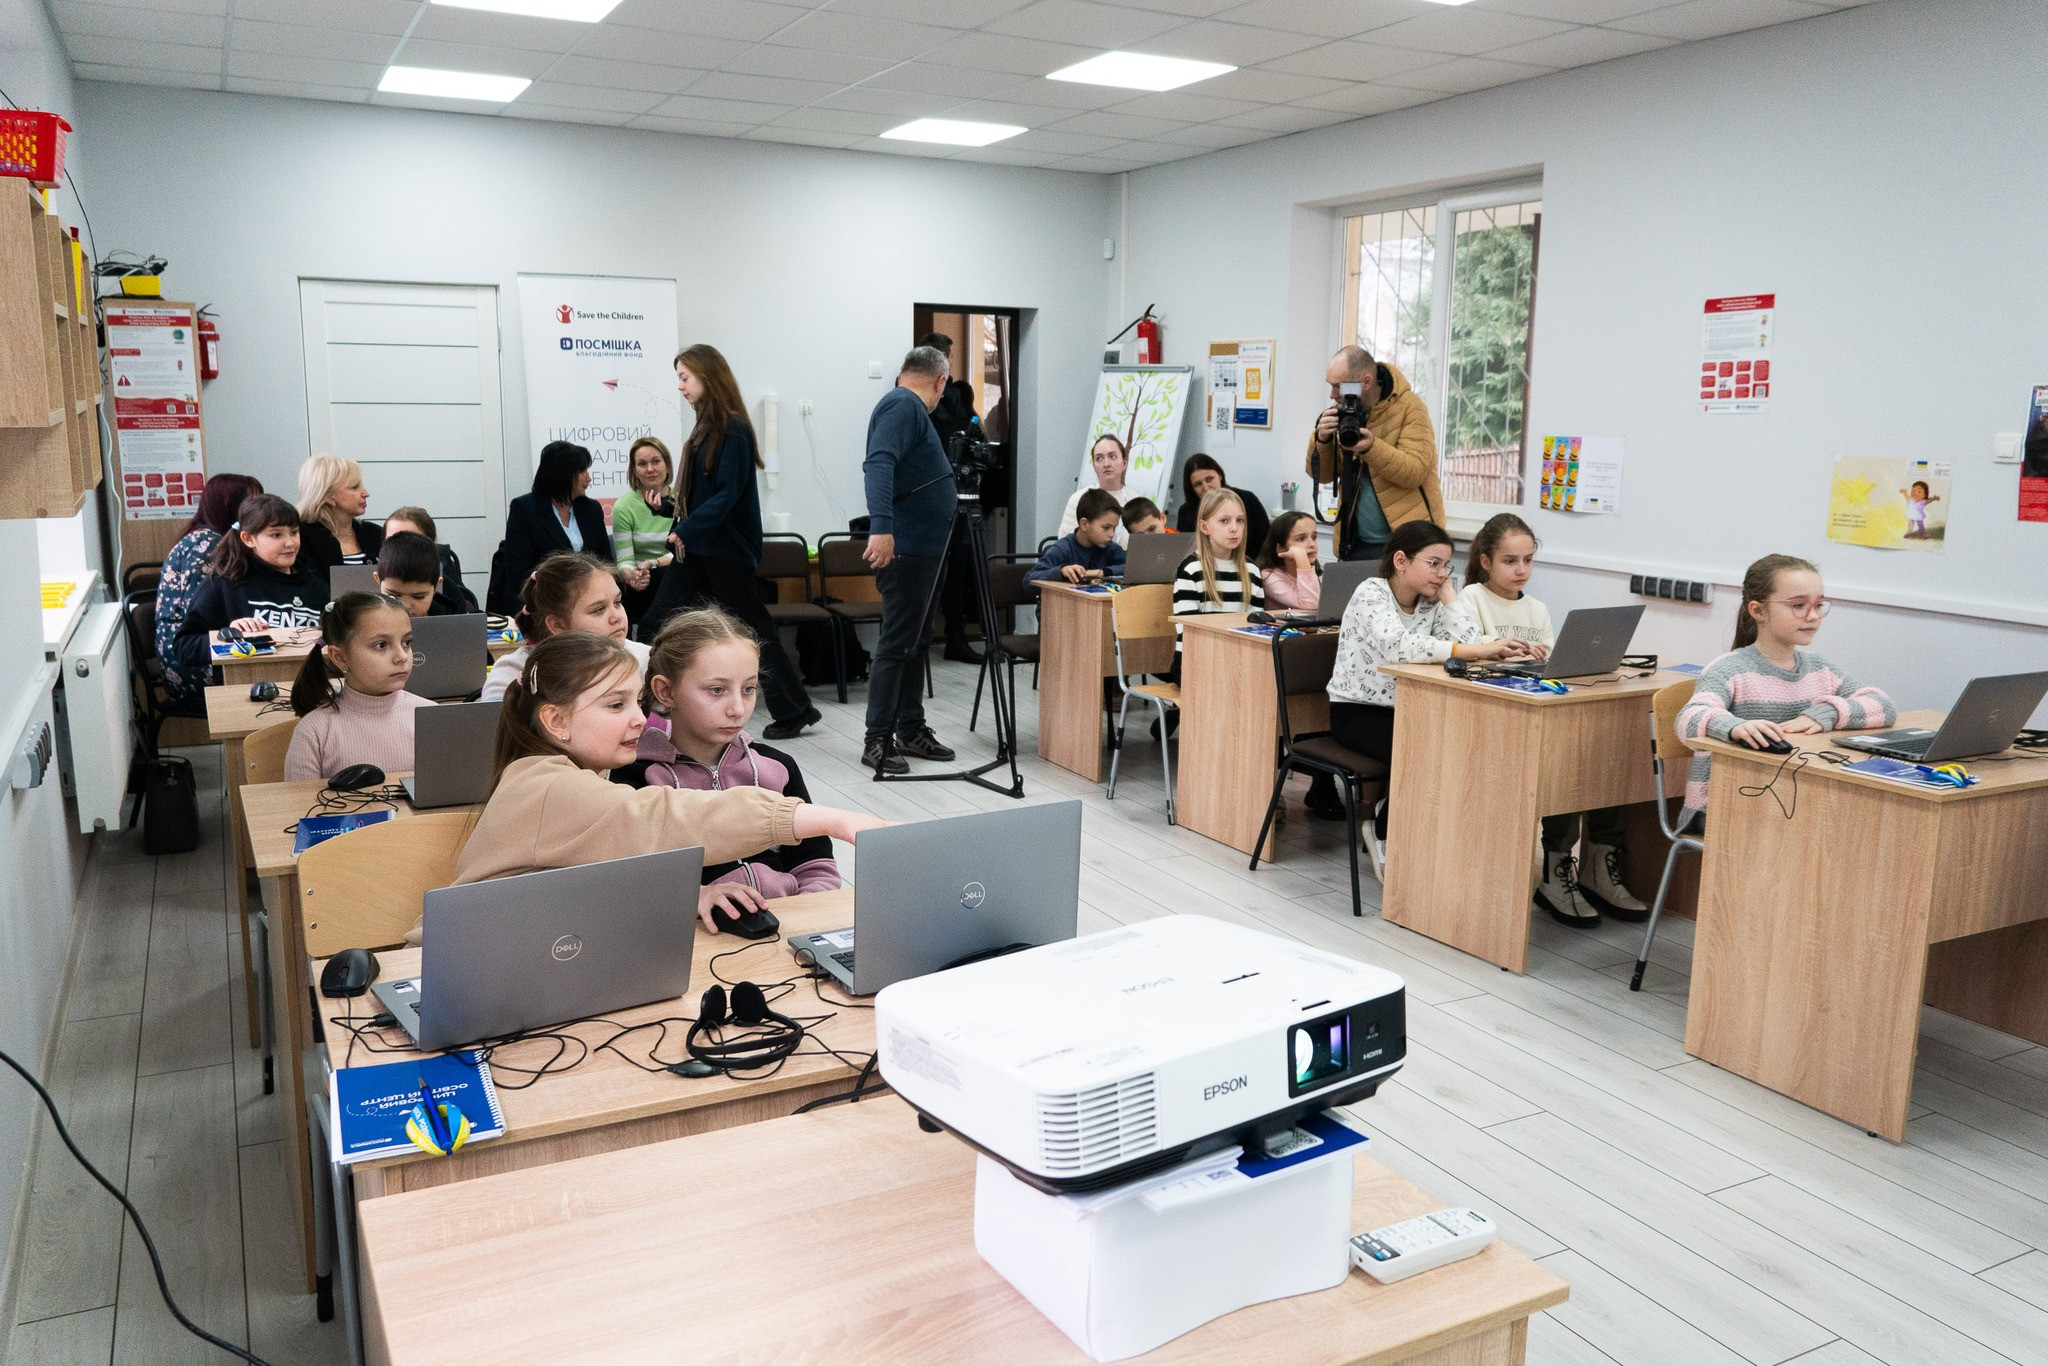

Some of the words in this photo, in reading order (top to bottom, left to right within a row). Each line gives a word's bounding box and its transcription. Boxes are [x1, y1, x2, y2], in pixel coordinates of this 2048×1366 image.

[577, 311, 596, 319] Save
[598, 311, 610, 320] the
[611, 311, 644, 321] Children
[575, 338, 642, 351] ПОСМІШКА
[549, 423, 652, 443] ЦИФРОВИЙ
[253, 609, 321, 629] KENZO
[964, 890, 983, 900] DELL
[555, 942, 579, 953] DELL
[407, 1082, 469, 1098] ОСВІТІЙ
[1204, 1075, 1248, 1101] EPSON
[360, 1094, 405, 1106] ЦЕНТР
[379, 1090, 456, 1109] ЦИРОВИЙ
